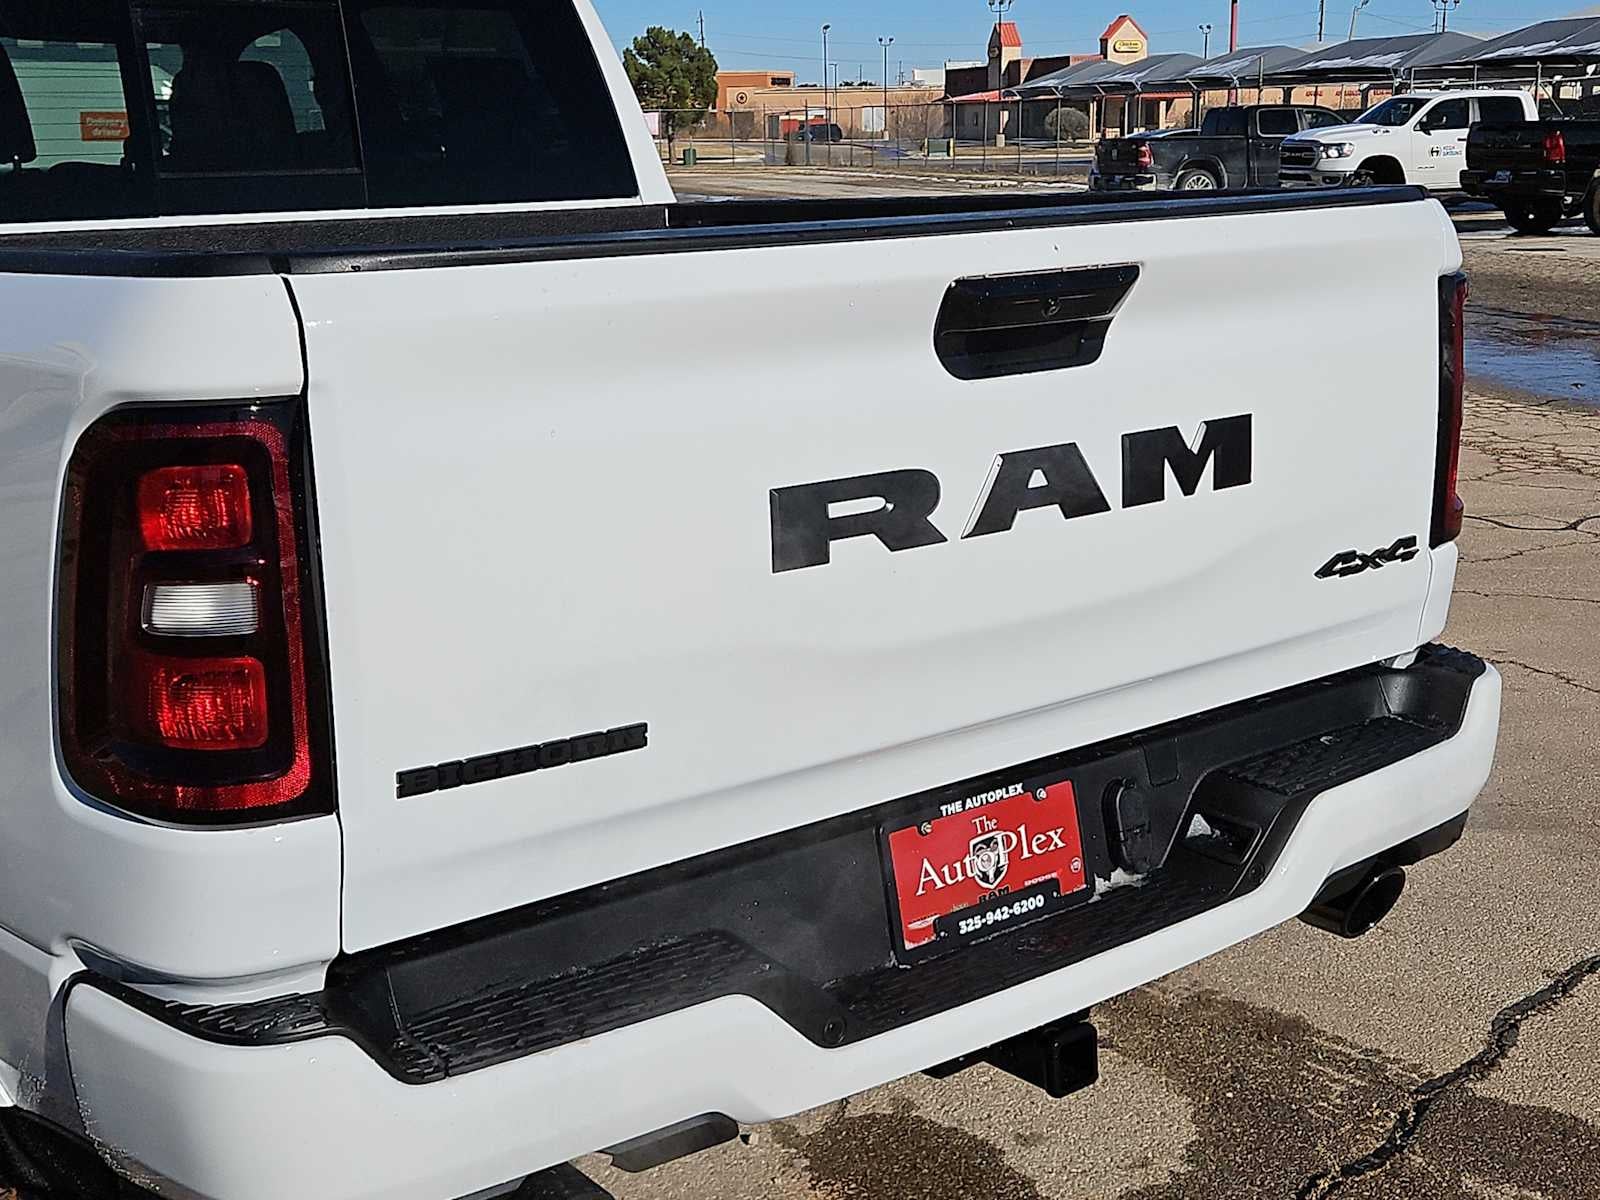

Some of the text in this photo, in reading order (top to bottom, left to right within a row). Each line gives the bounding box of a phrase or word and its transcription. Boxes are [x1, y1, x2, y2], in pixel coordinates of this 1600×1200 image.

[769, 413, 1253, 574] RAM
[940, 783, 1024, 817] THE AUTOPLEX
[971, 816, 998, 834] The
[915, 824, 1067, 896] AutoPlex
[958, 894, 1045, 935] 325-942-6200
